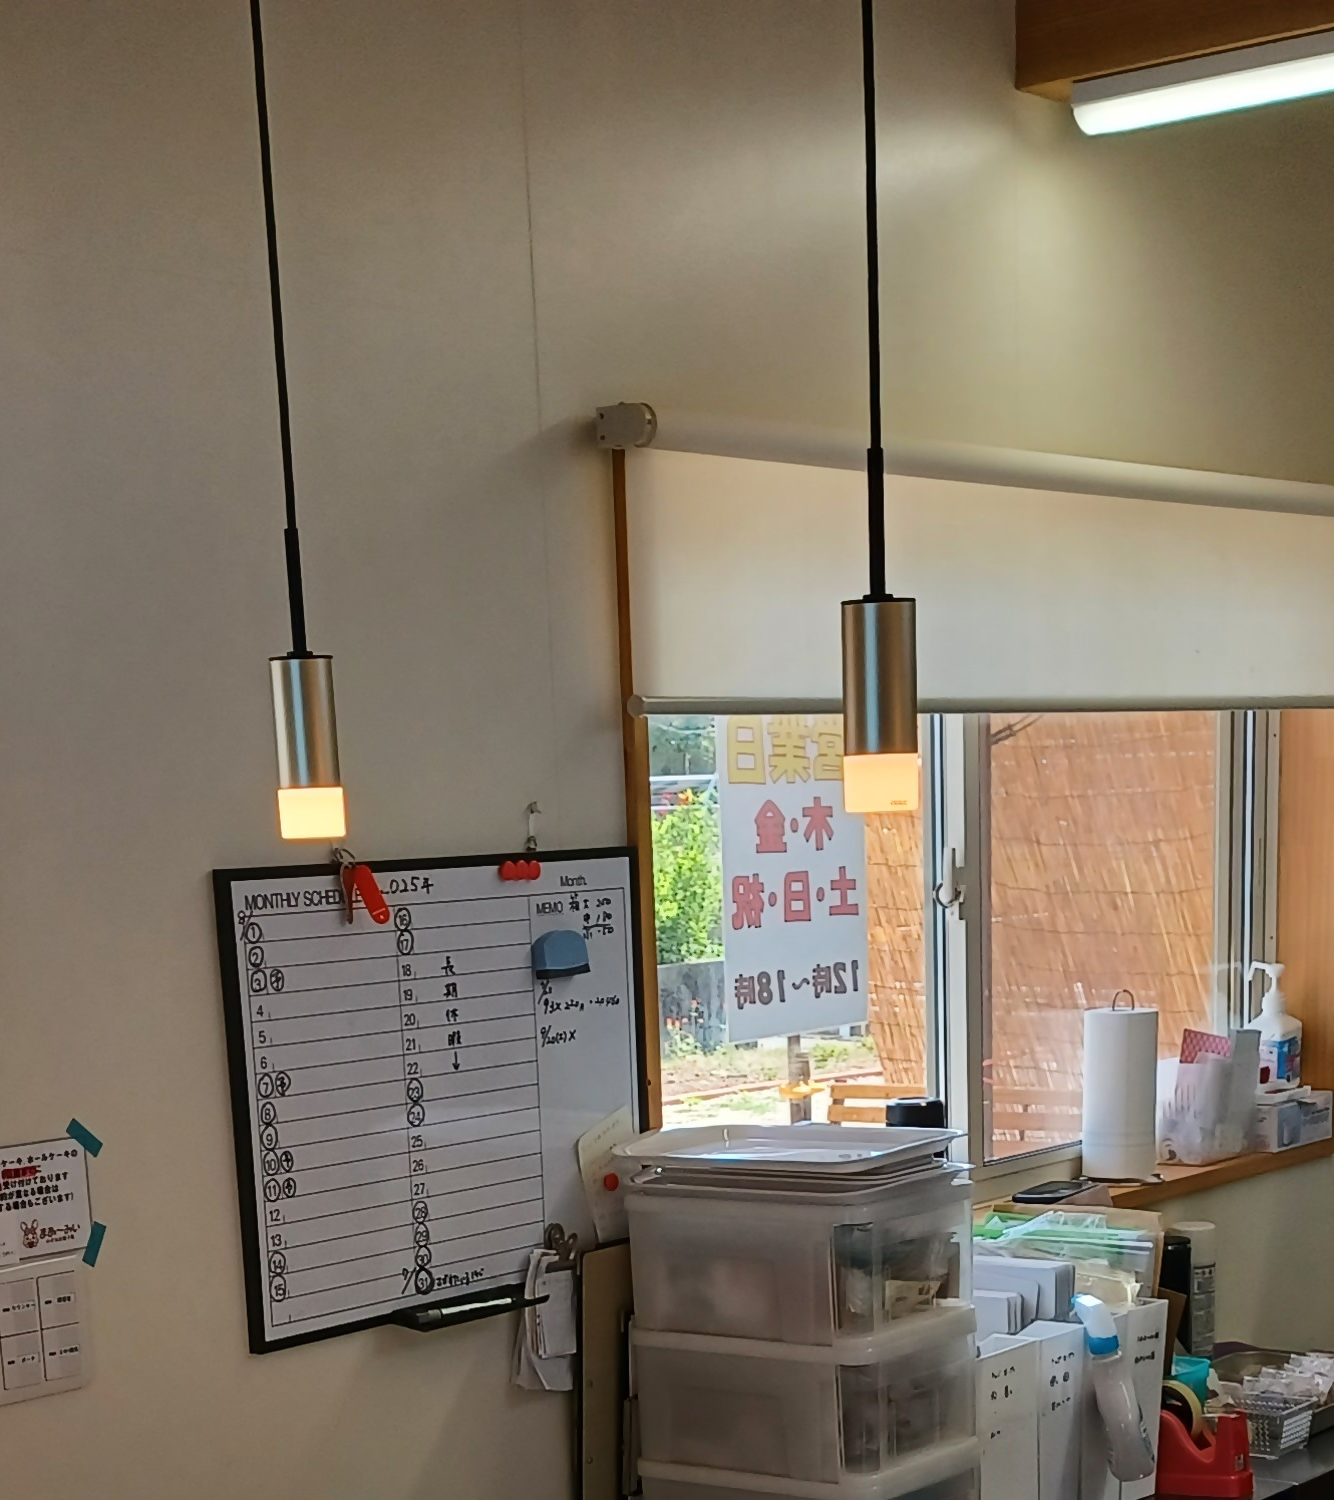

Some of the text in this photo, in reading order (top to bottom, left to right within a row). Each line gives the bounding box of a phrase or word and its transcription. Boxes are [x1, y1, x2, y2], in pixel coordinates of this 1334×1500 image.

[245, 890, 300, 911] MONTHLY
[536, 901, 564, 915] MEMO
[401, 963, 412, 977] 18
[403, 988, 413, 1001] 19
[256, 1005, 264, 1018] 4
[404, 1013, 416, 1026] 20
[258, 1031, 267, 1044] 5
[405, 1038, 416, 1051] 21
[260, 1057, 268, 1070] 6
[407, 1062, 419, 1075] 22
[411, 1135, 424, 1147] 25
[412, 1159, 425, 1171] 26
[413, 1183, 426, 1196] 27
[270, 1209, 281, 1222] 12
[270, 1234, 282, 1247] 13
